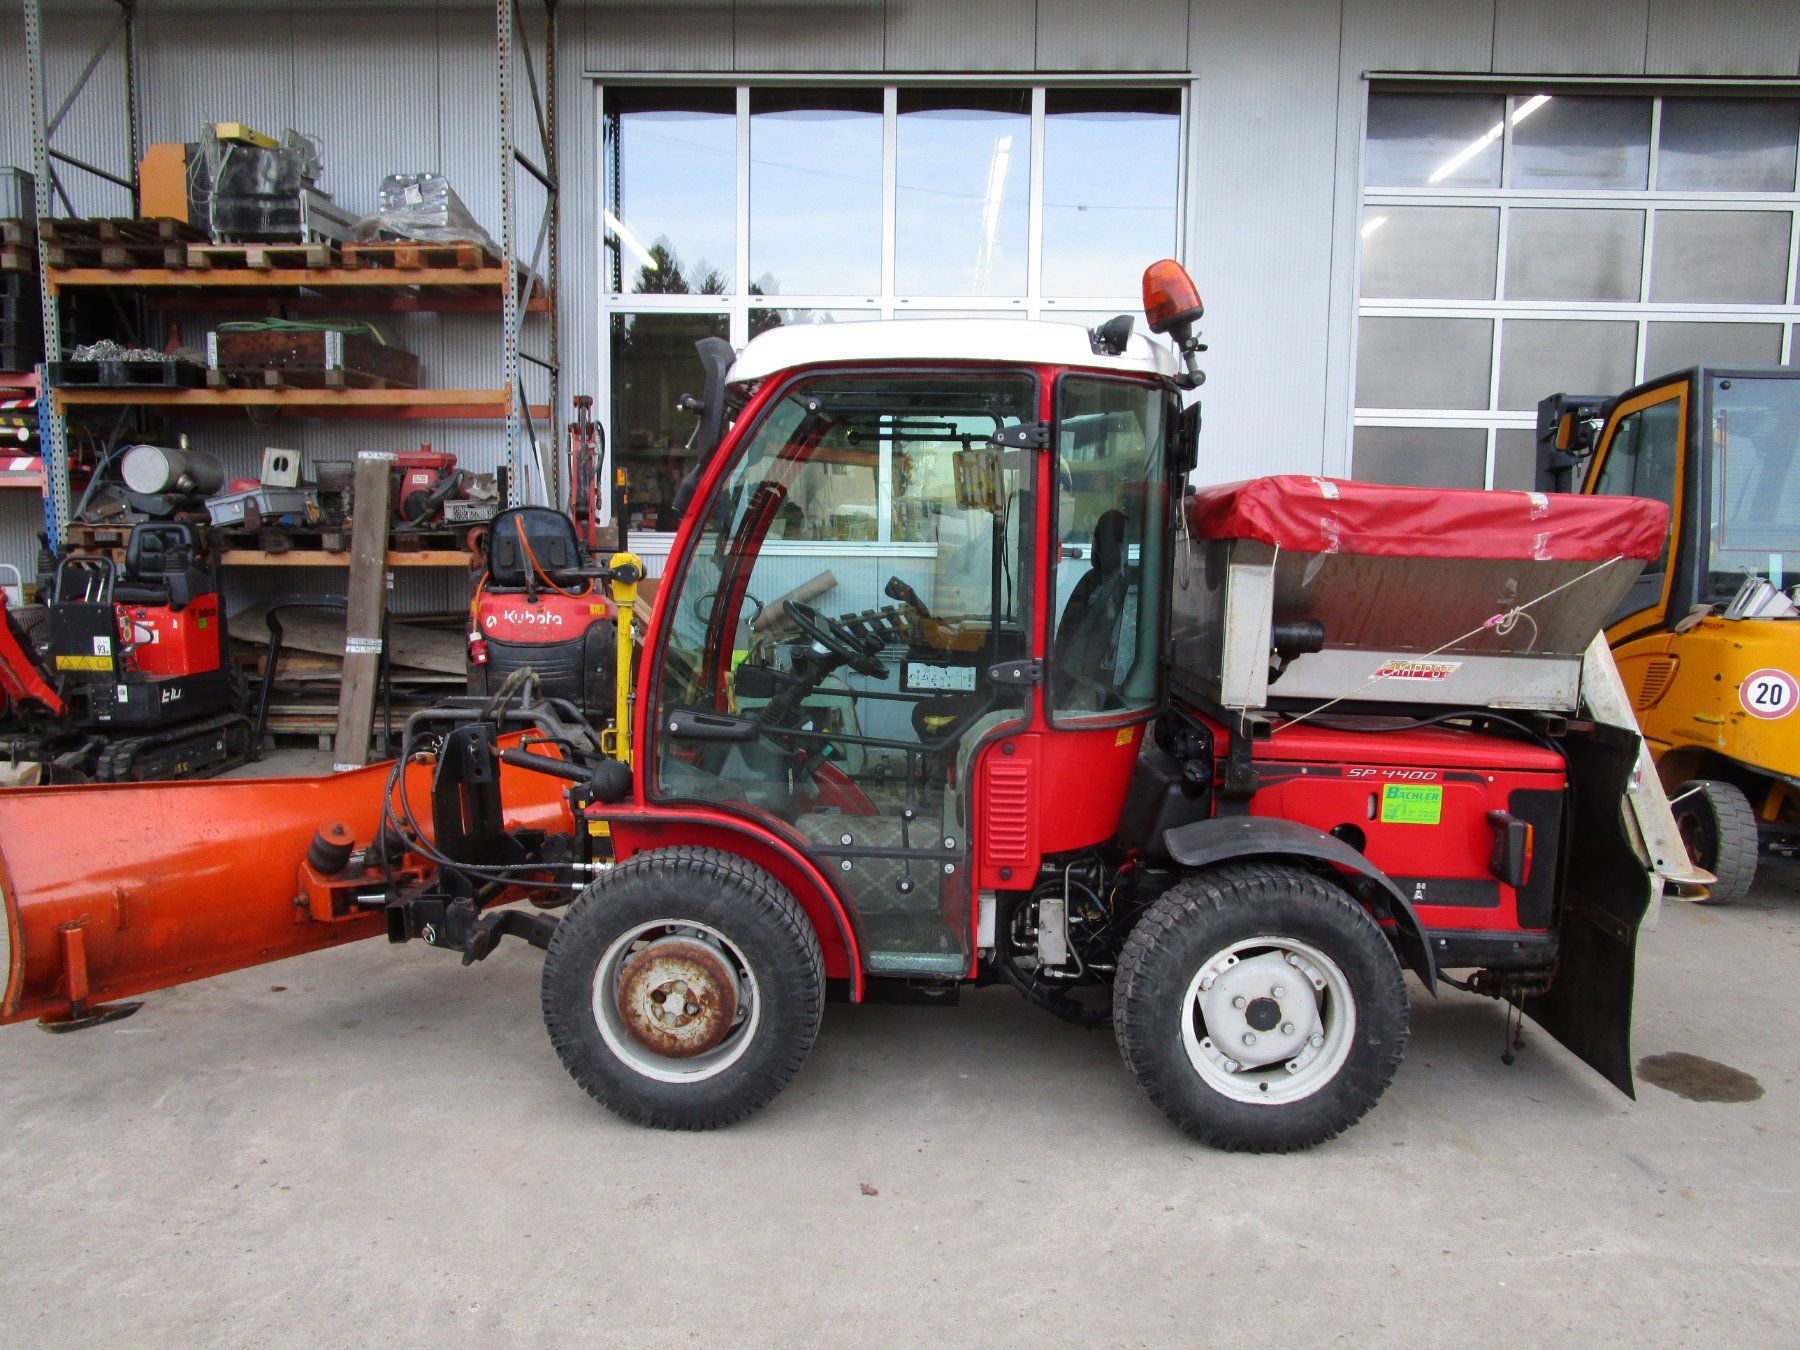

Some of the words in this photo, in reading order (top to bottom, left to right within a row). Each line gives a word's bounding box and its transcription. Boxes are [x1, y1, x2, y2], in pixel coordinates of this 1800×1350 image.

[503, 609, 563, 626] Kubota
[1755, 682, 1783, 706] 20
[1347, 768, 1377, 777] SP
[1382, 770, 1438, 780] 4400
